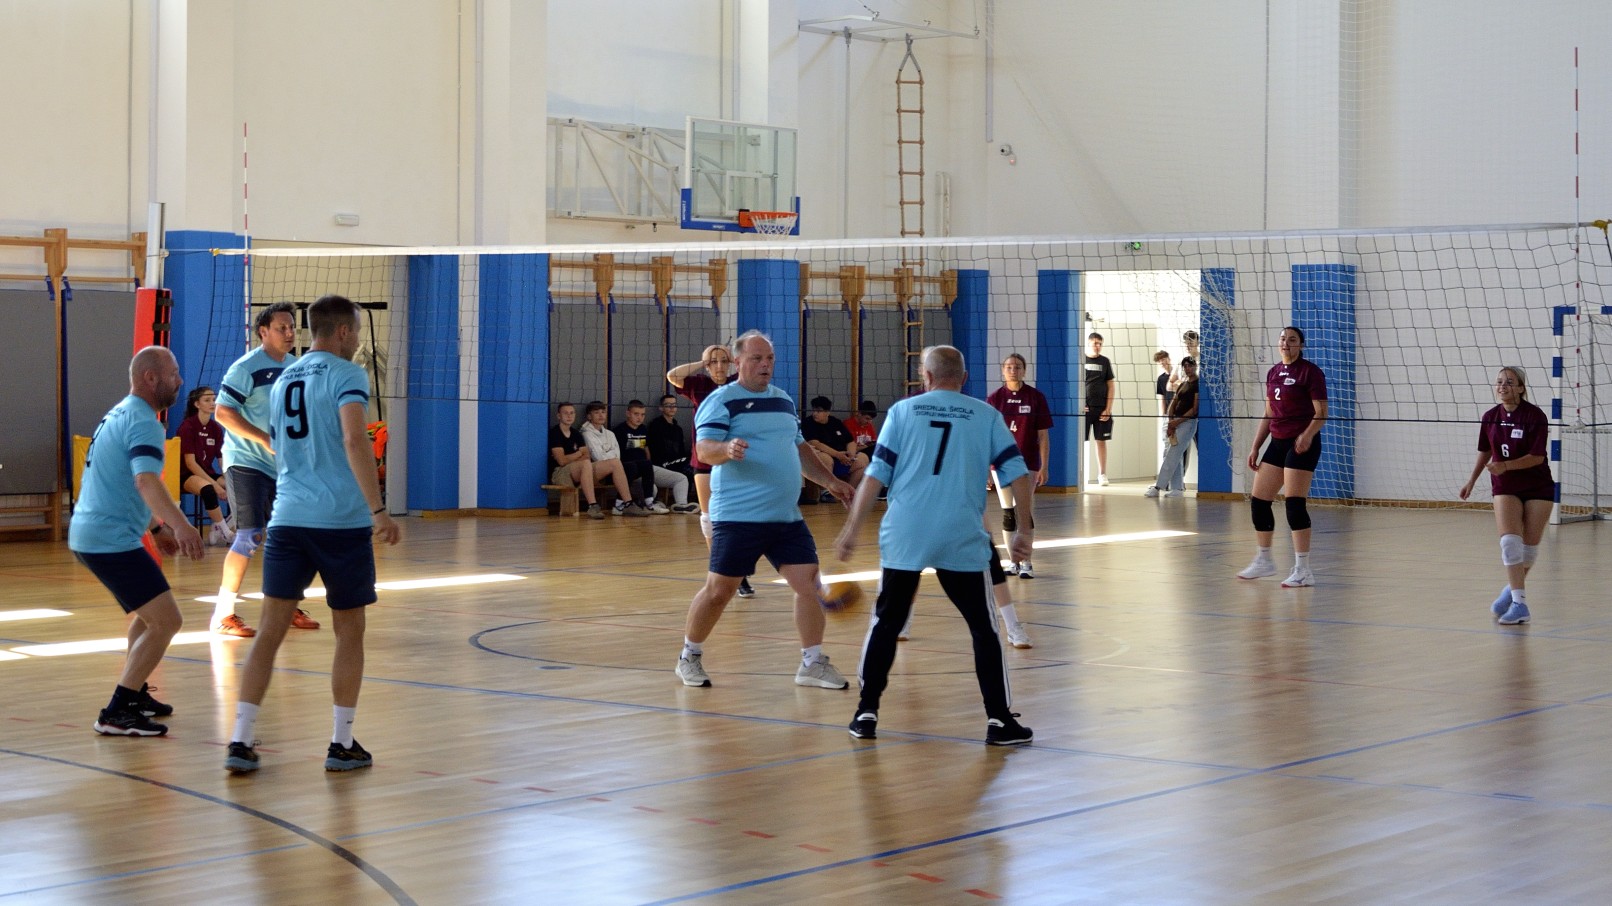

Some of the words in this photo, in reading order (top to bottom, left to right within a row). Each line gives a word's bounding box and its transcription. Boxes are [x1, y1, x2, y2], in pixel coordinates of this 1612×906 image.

[1274, 387, 1281, 401] 2
[285, 380, 309, 440] 9
[913, 404, 947, 412] SREDNJA
[949, 405, 974, 415] ŠKOLA
[1010, 420, 1018, 433] 4
[930, 420, 952, 475] 7
[1501, 443, 1510, 458] 6
